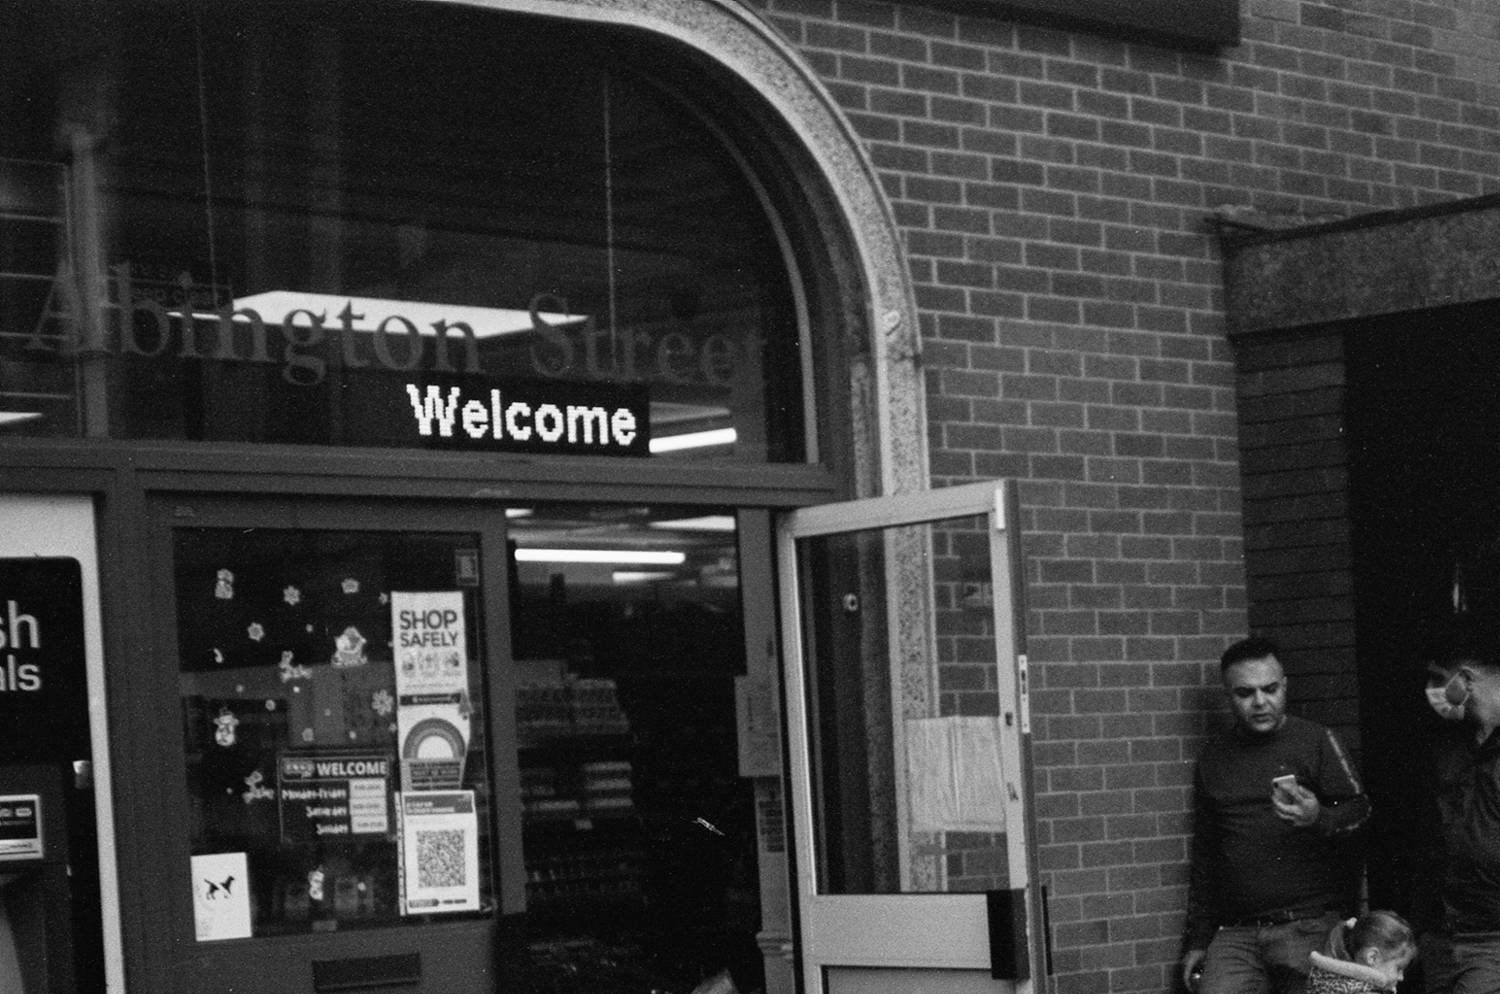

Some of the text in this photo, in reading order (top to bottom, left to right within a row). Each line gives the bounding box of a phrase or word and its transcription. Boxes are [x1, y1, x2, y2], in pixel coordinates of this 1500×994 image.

[25, 256, 768, 386] Abington Street
[406, 383, 637, 447] Welcome
[399, 609, 458, 630] SHOP
[399, 632, 459, 648] SAFELY
[316, 761, 387, 776] WELCOME
